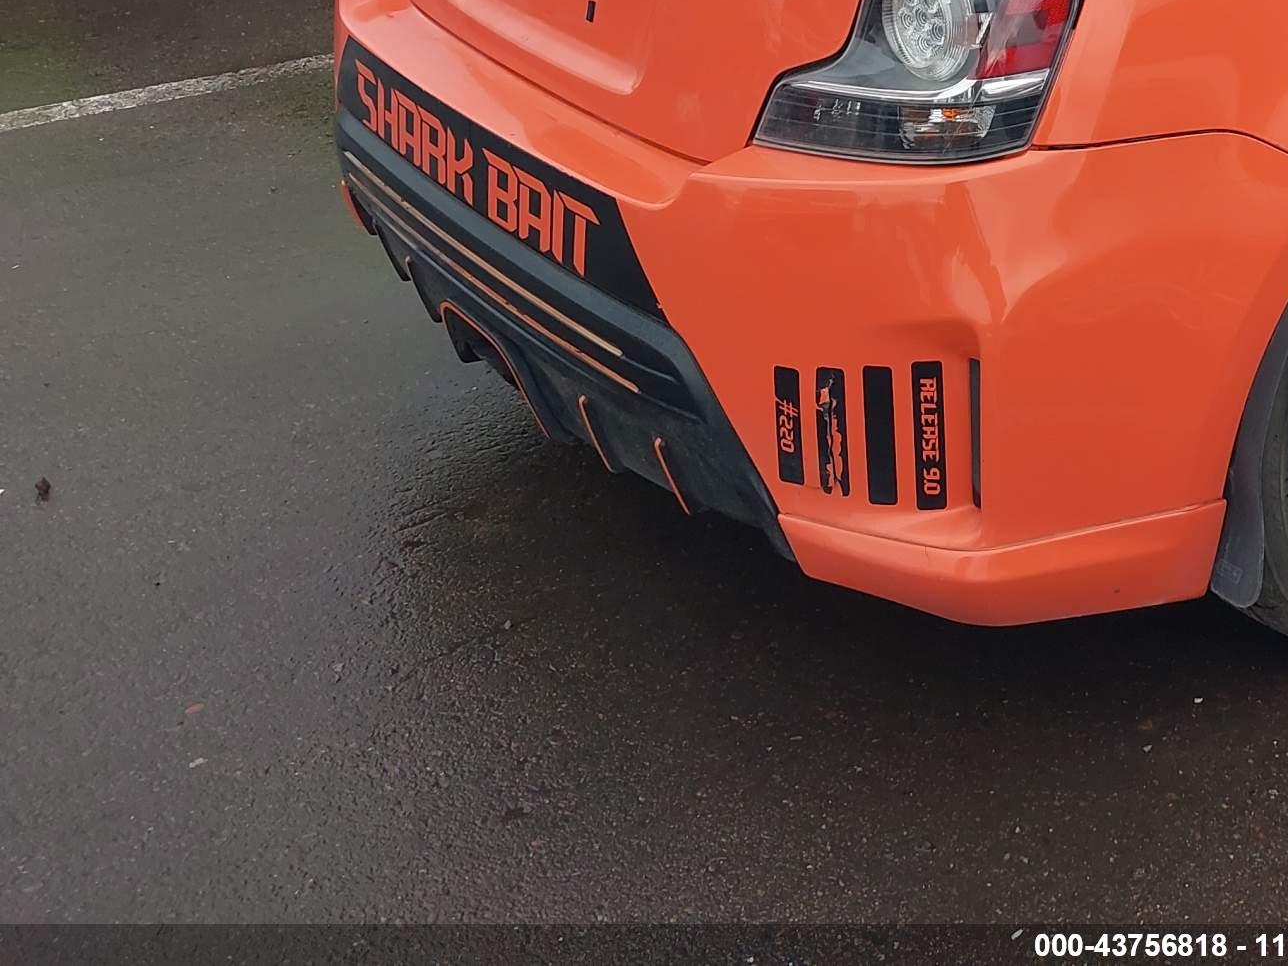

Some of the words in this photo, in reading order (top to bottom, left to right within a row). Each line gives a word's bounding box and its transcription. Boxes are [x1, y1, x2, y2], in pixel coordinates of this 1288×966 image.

[354, 58, 474, 208] SHARK
[481, 146, 601, 279] BAIT
[775, 397, 799, 454] #220
[918, 376, 940, 464] RELEASE
[922, 466, 941, 496] 9.0
